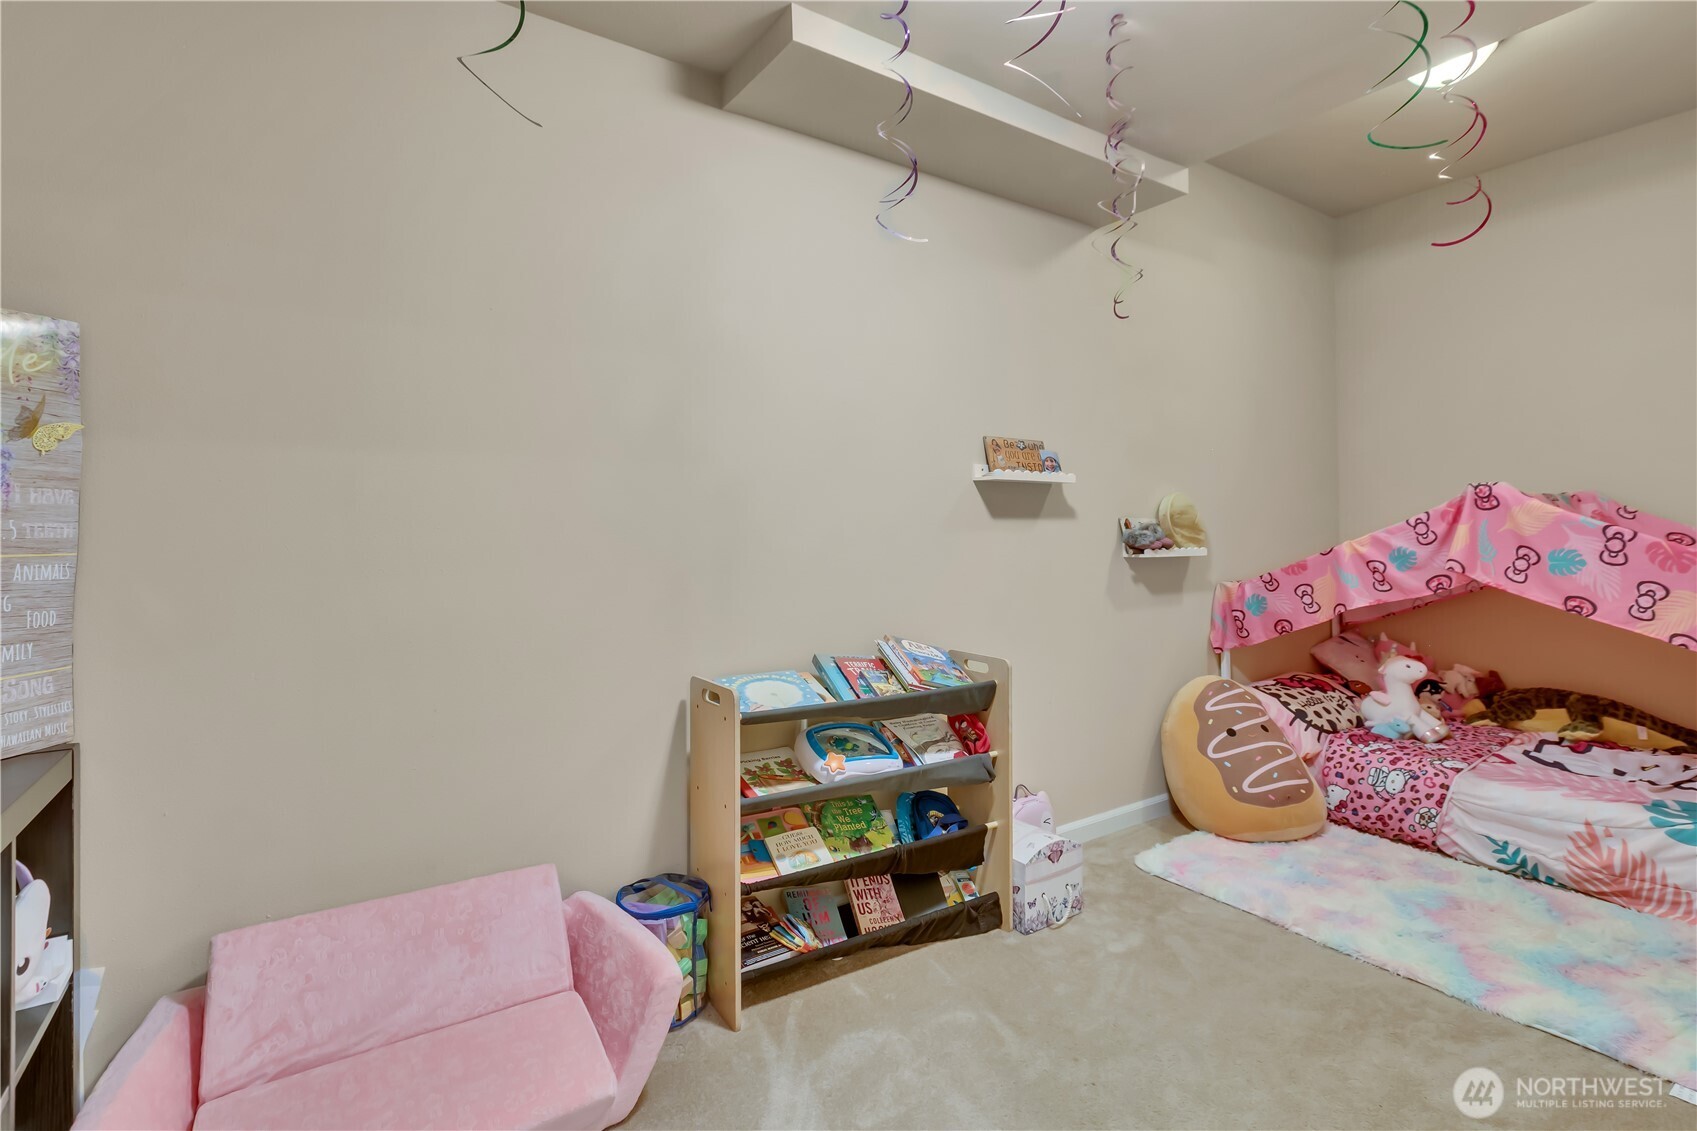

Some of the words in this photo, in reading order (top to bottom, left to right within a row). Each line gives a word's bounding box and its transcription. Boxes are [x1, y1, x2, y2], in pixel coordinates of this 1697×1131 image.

[1002, 439, 1015, 449] Be
[1016, 461, 1043, 472] INSID
[13, 562, 70, 582] ANIMALS
[26, 609, 57, 629] FOOD
[1, 675, 54, 704] SONG
[44, 721, 69, 737] MUSIC
[842, 806, 864, 816] Tree
[836, 814, 852, 823] We
[833, 820, 868, 833] Planted
[775, 839, 792, 848] HOW
[793, 834, 815, 843] MUCH
[781, 843, 803, 852] LOVE
[802, 838, 819, 847] YOU
[852, 886, 883, 902] WITH
[856, 901, 874, 916] US
